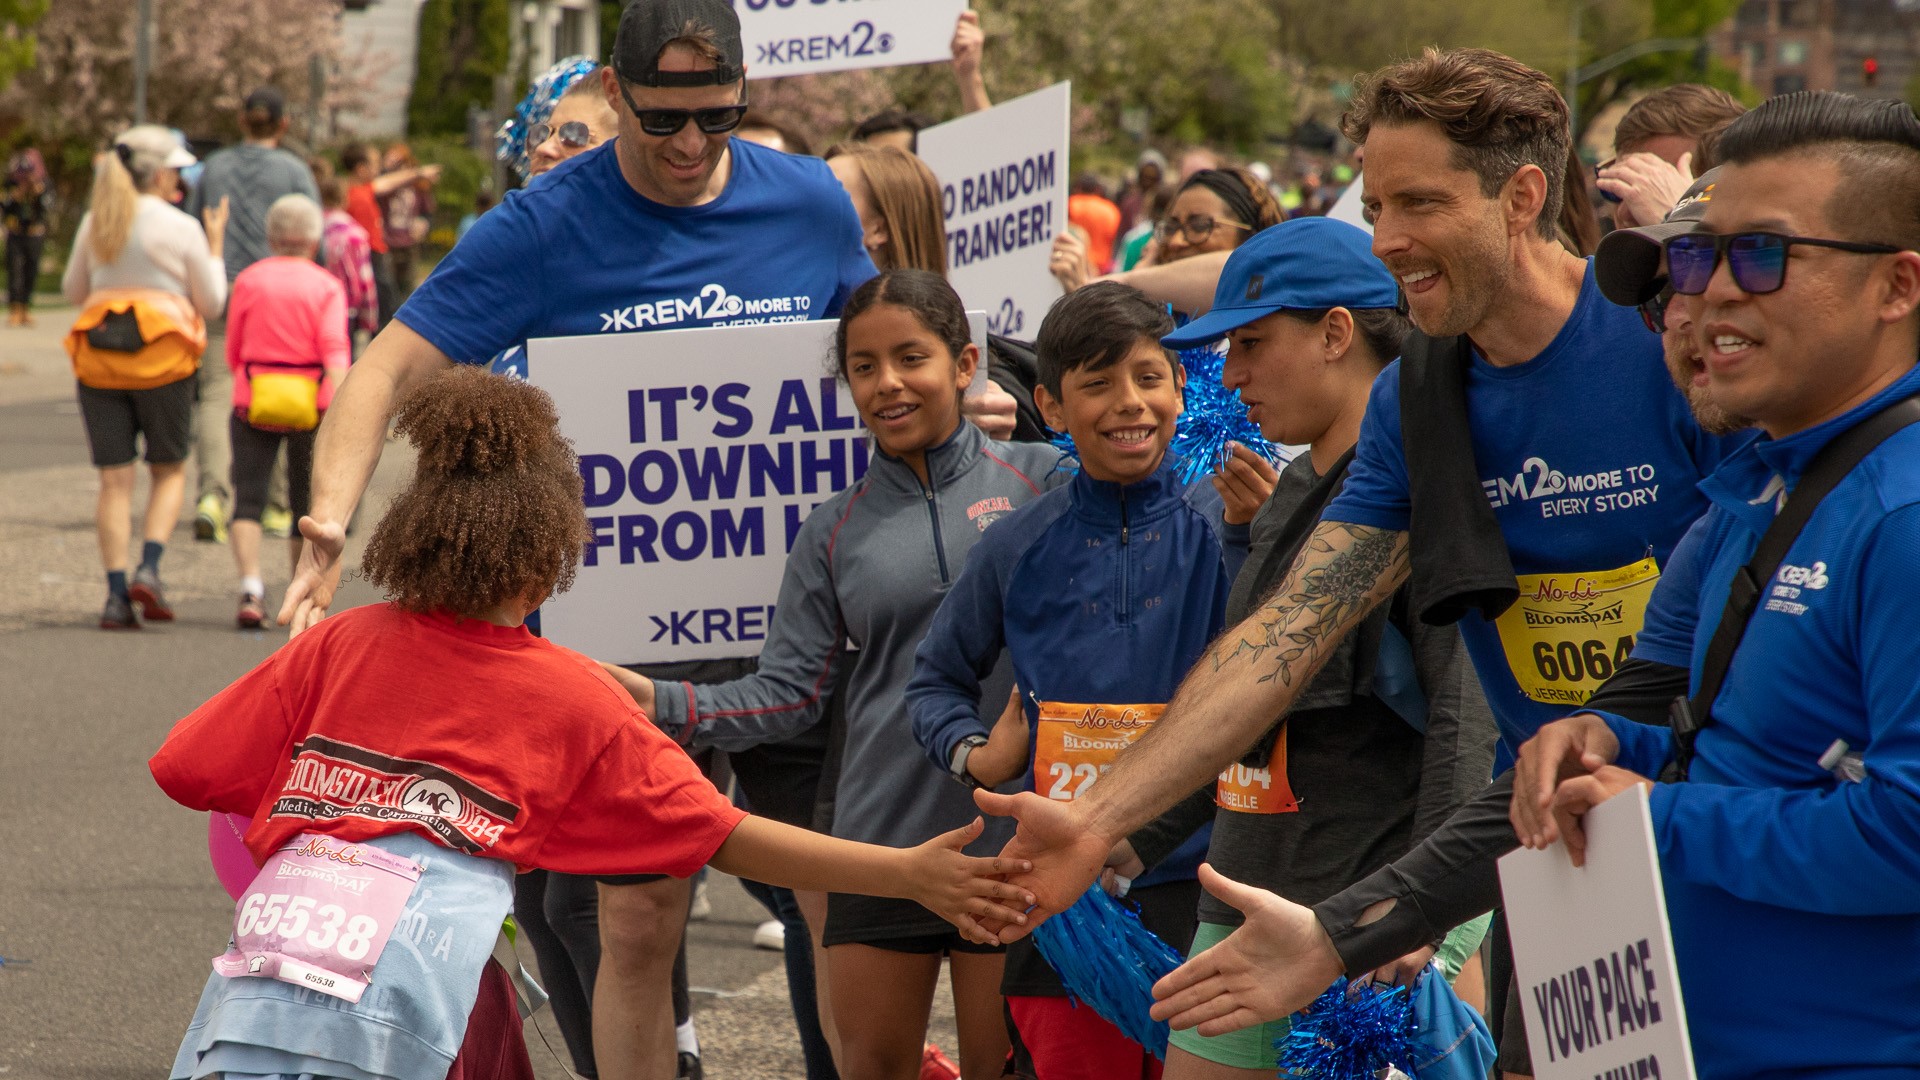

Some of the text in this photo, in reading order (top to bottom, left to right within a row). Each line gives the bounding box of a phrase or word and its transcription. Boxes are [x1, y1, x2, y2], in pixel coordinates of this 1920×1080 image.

[962, 151, 1055, 216] RANDOM
[745, 297, 791, 315] MORE
[793, 296, 811, 310] TO
[627, 382, 754, 444] IT'S
[579, 436, 869, 508] DOWNHI
[1568, 469, 1623, 493] MORE
[1626, 463, 1655, 484] TO
[1541, 484, 1660, 519] EVERY STORY
[583, 506, 767, 567] FROM
[1530, 577, 1603, 602] No-Li
[1524, 604, 1624, 626] BLOOMSDAY
[1535, 687, 1584, 703] JEREMY
[1075, 706, 1146, 729] No-Li
[297, 836, 364, 866] No-Li
[277, 861, 371, 893] BLOOMSDAY
[237, 892, 379, 961] 65538
[305, 973, 335, 988] 65538
[1533, 938, 1662, 1063] YOUR PACE
